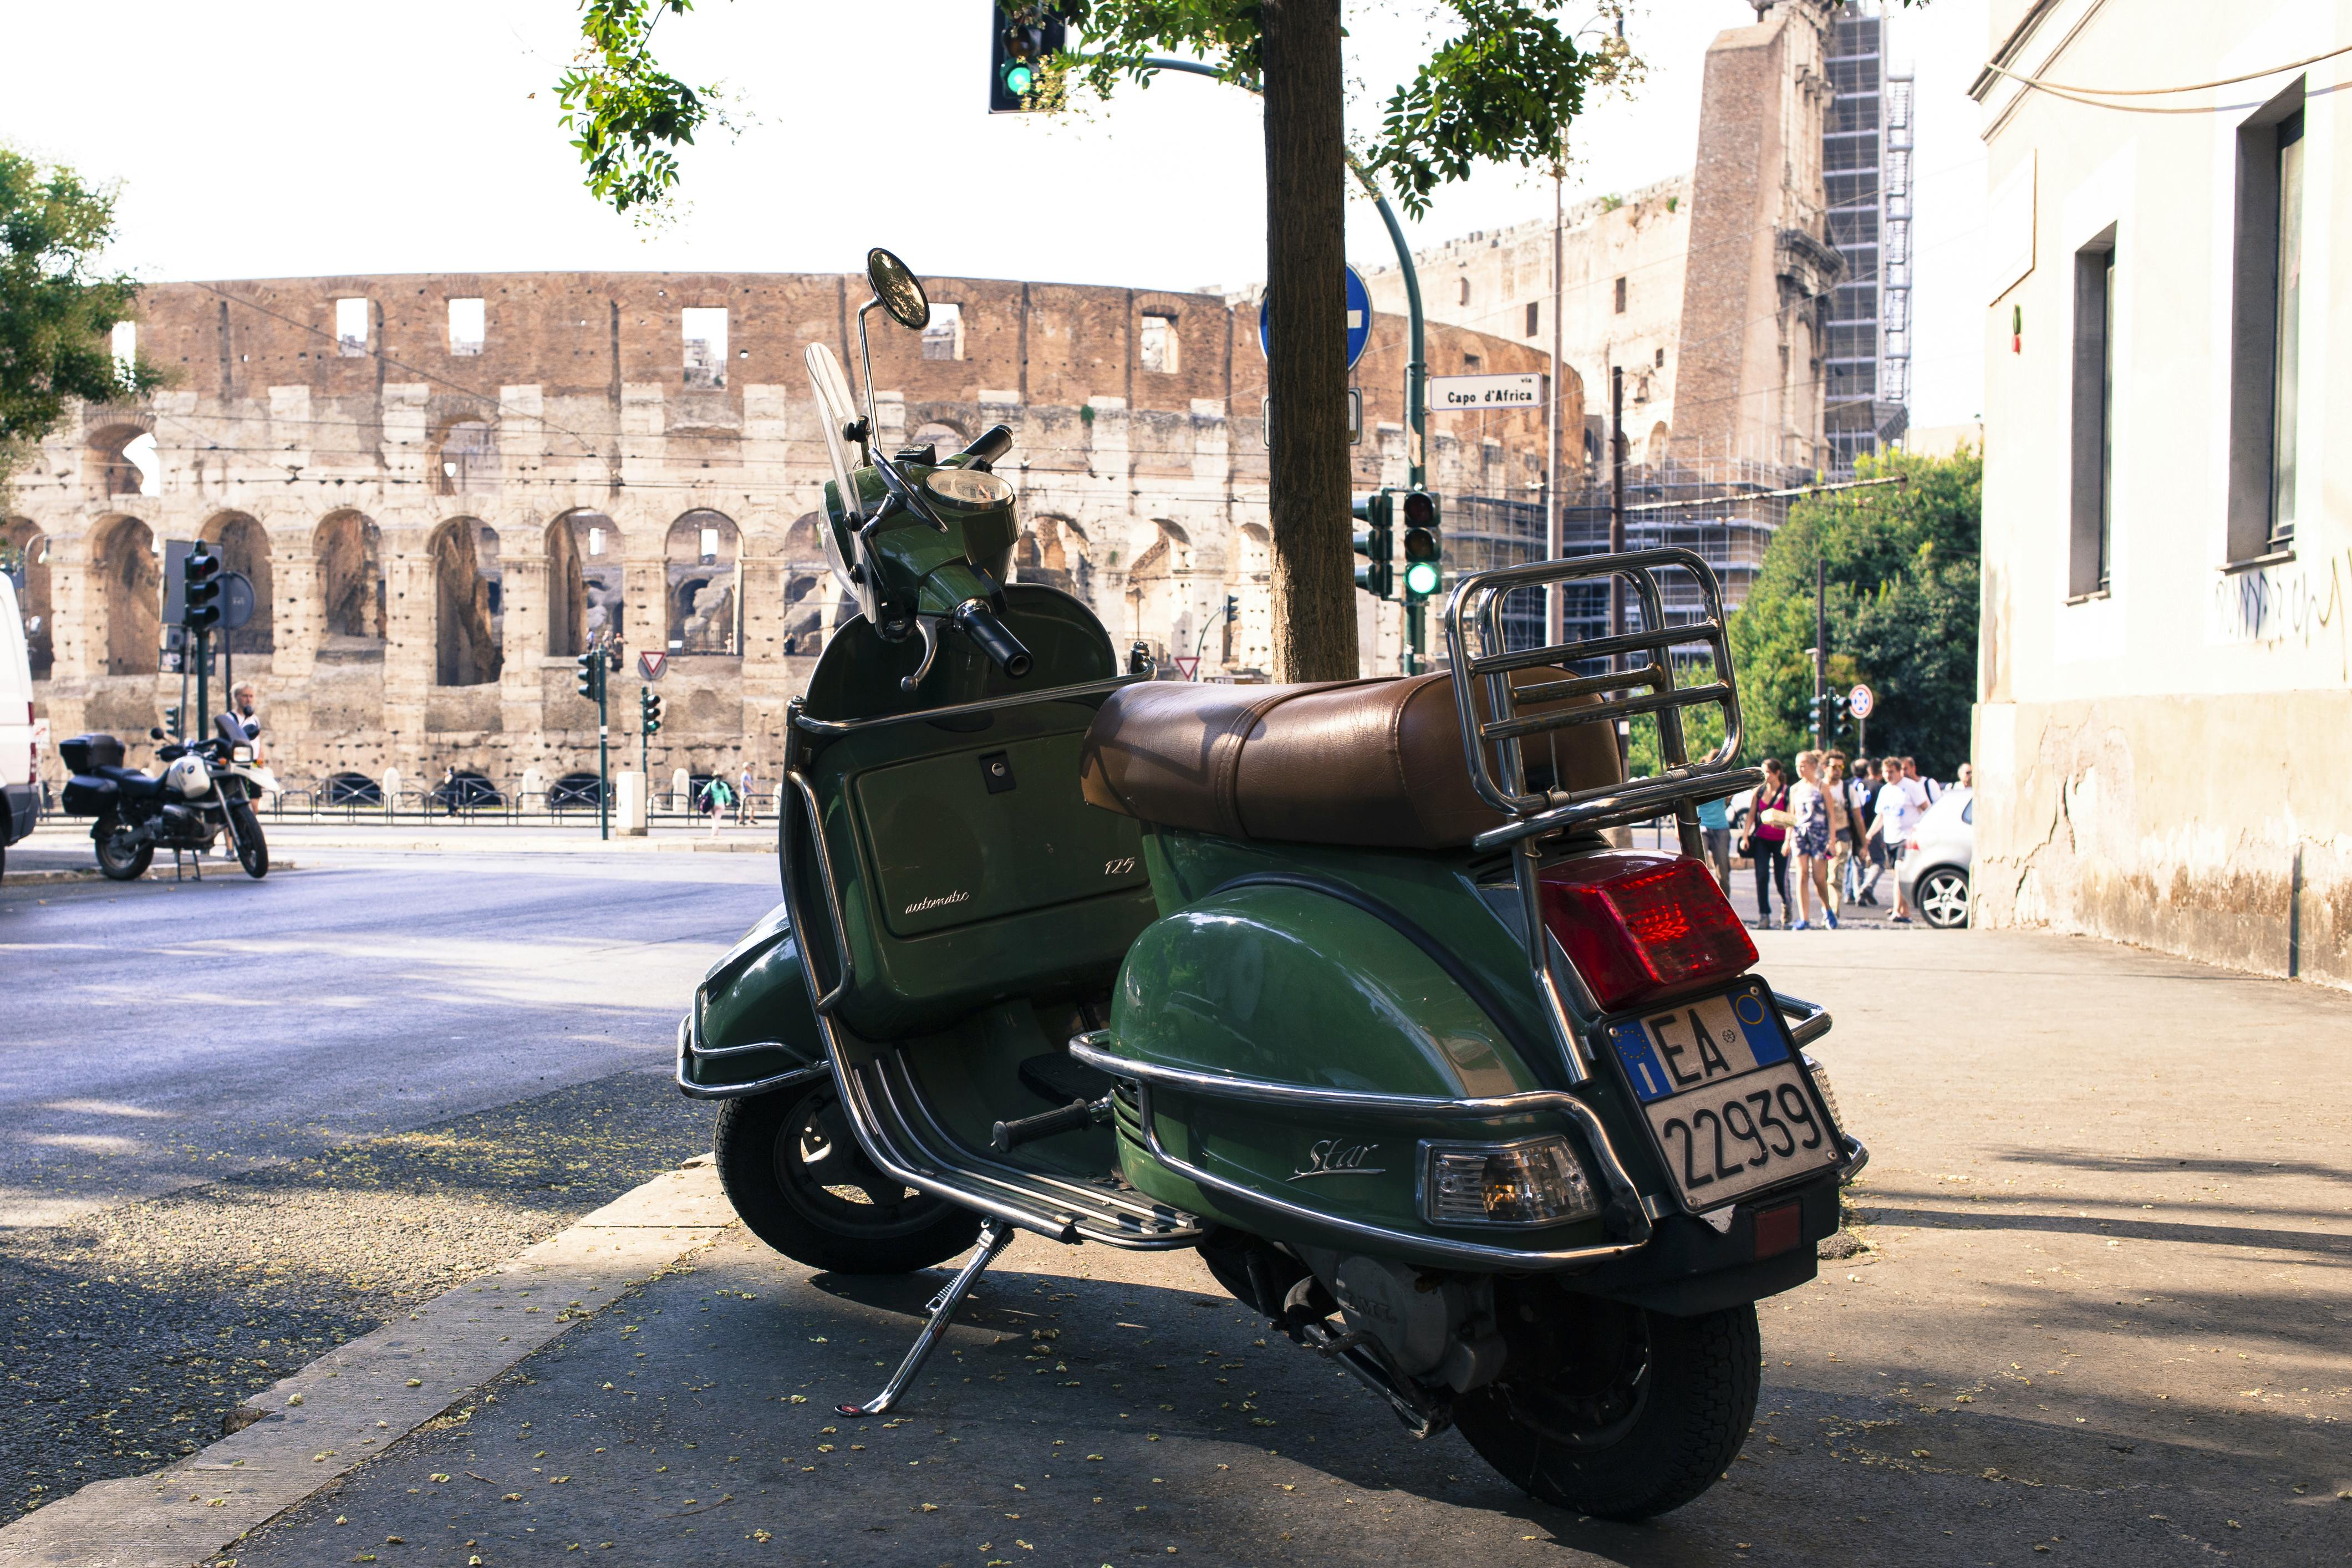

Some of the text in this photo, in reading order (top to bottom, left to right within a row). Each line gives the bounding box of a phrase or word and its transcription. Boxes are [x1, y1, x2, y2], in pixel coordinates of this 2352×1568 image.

[1448, 389, 1532, 405] Capo d'Africa
[1105, 857, 1135, 875] 125
[905, 889, 970, 914] automatic
[1648, 1009, 1730, 1086] EA
[1663, 1083, 1821, 1190] 22939
[1294, 1138, 1379, 1176] Star
[1343, 1290, 1397, 1323] LML
